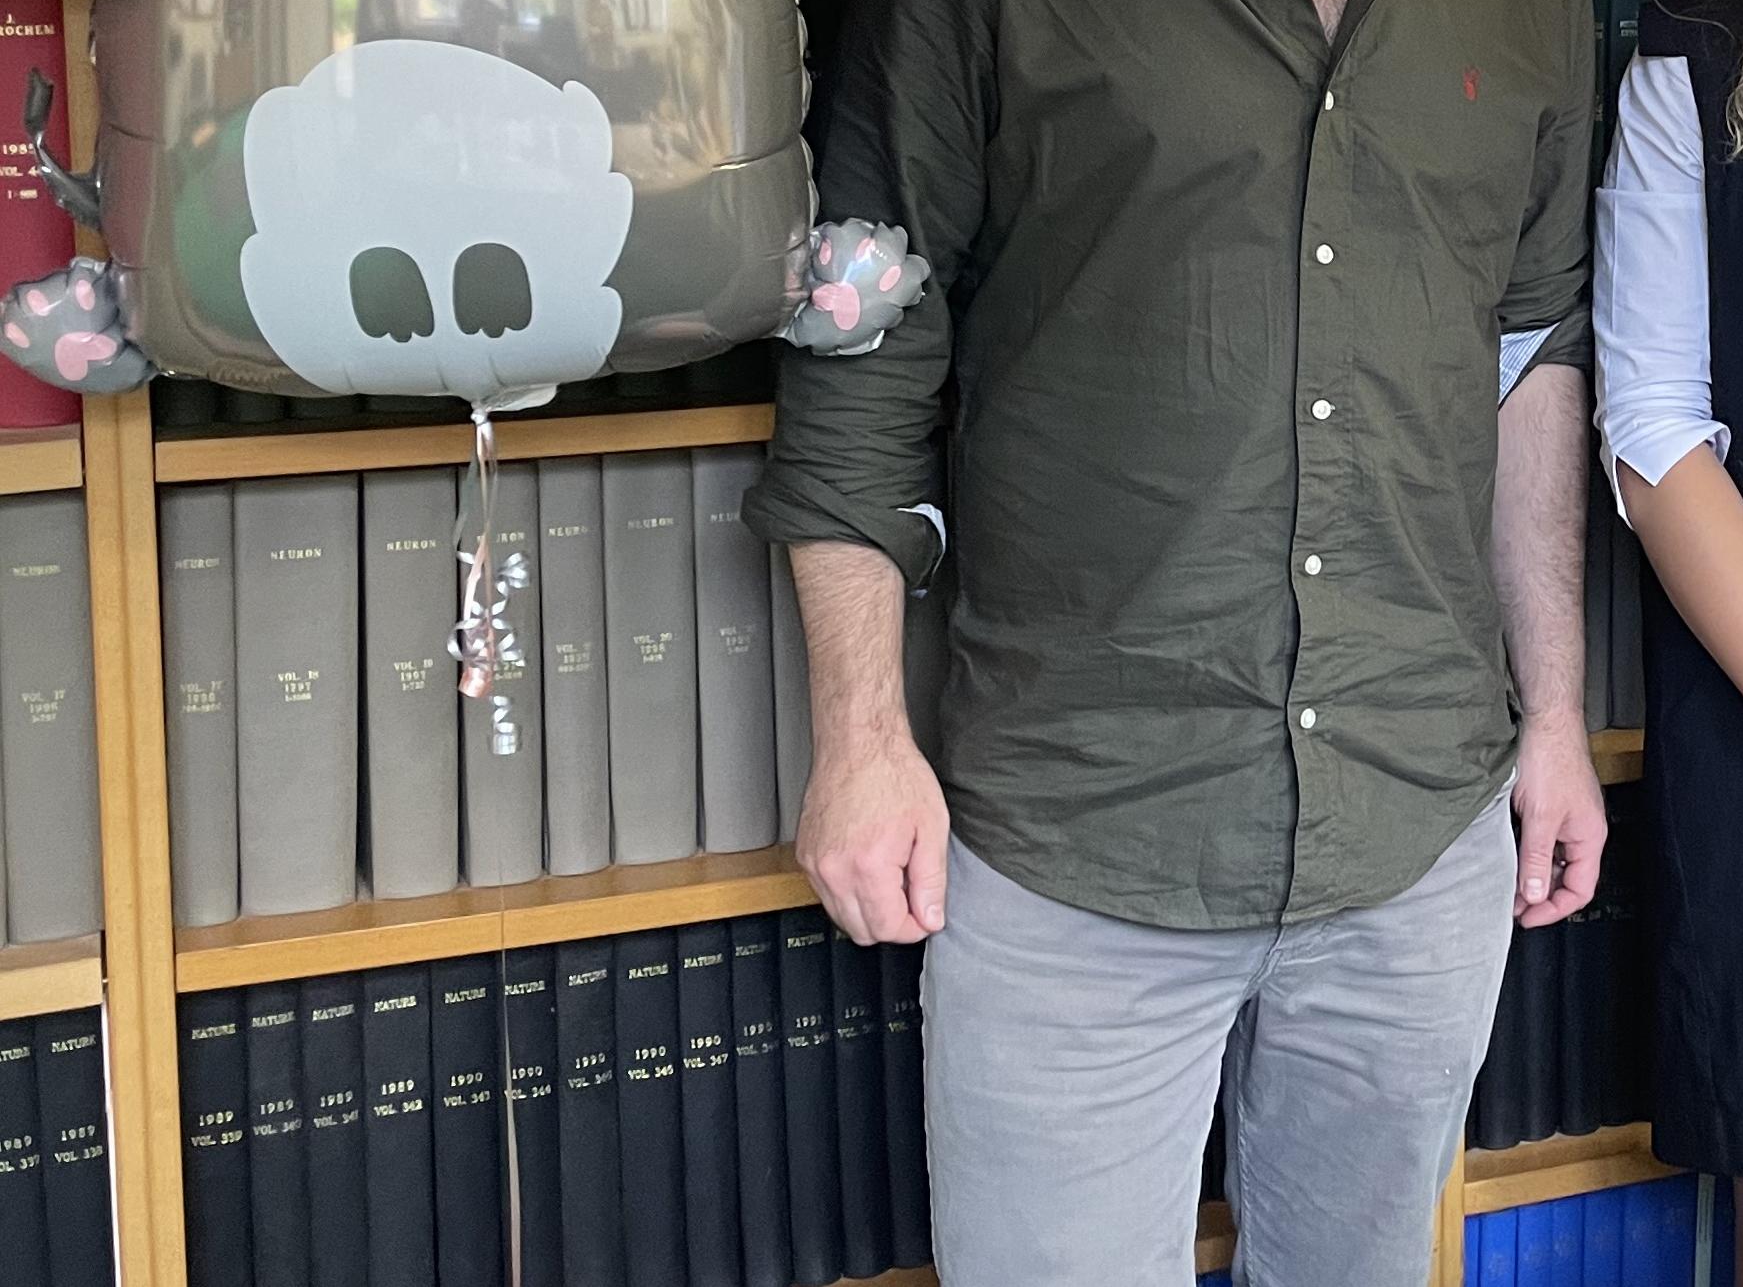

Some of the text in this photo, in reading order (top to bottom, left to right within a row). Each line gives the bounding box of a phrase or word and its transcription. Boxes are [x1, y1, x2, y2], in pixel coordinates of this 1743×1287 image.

[684, 953, 722, 969] NATURE
[568, 969, 607, 986] NATURE
[628, 964, 668, 980] NATURE
[444, 987, 486, 1004] NATURE
[504, 980, 545, 996] NATURE
[374, 995, 417, 1013] NATURE
[252, 1011, 295, 1028] NATURE
[312, 1004, 353, 1022] NATURE
[191, 1023, 236, 1040] NATURE
[52, 1035, 96, 1053] NATURE
[690, 1035, 721, 1049] 1990
[575, 1053, 605, 1069] 1990
[635, 1046, 666, 1060] 1990
[710, 1053, 728, 1066] 347
[450, 1072, 483, 1087] 1990
[512, 1065, 543, 1080] 1990
[381, 1079, 414, 1095] 1989
[260, 1099, 294, 1115] 1989
[320, 1091, 353, 1107] 1989
[403, 1099, 423, 1113] 342
[199, 1111, 234, 1127] 1989
[61, 1125, 95, 1141] 1989
